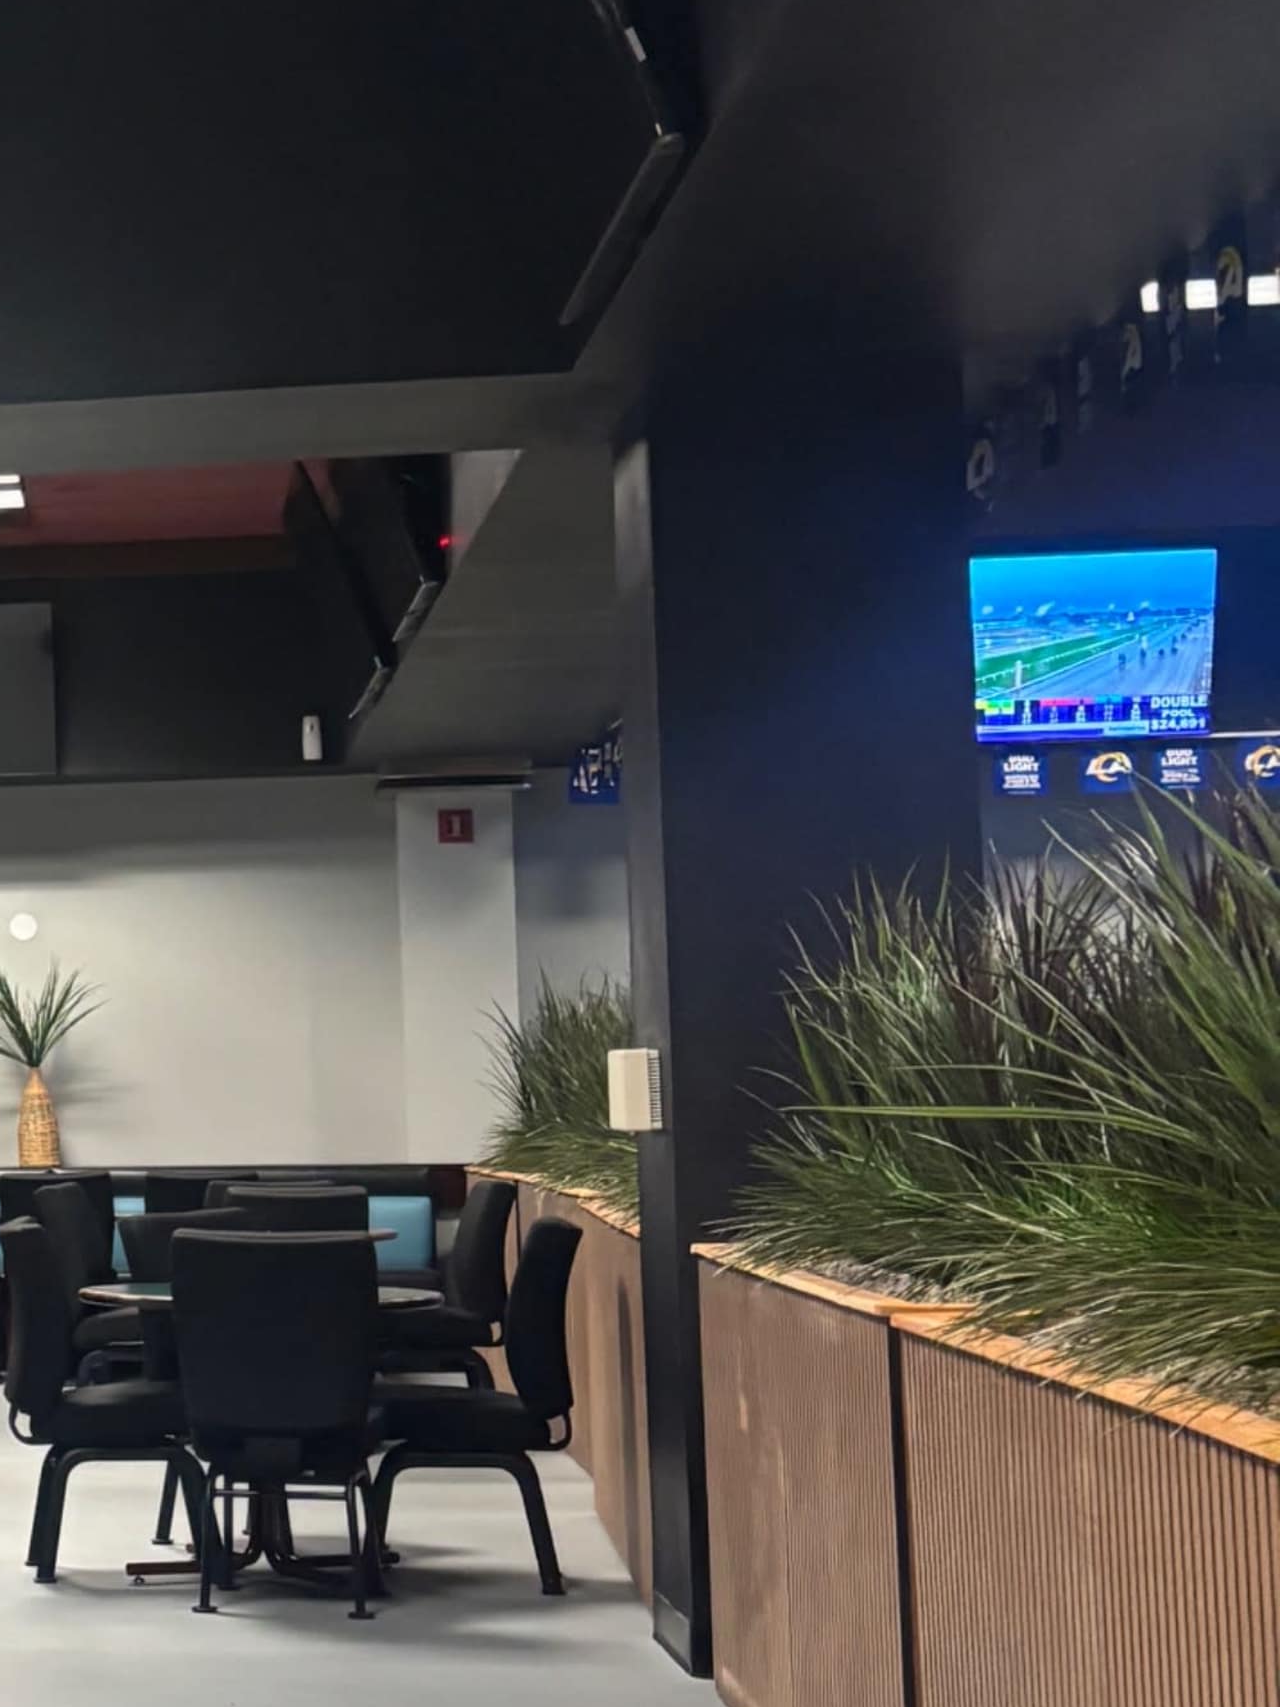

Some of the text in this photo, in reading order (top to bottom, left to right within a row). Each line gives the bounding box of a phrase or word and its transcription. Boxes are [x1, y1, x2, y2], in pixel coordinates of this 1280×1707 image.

[1150, 695, 1208, 709] DOUBLE
[1161, 708, 1195, 718] POOL
[1161, 756, 1198, 766] LIGHT
[1003, 762, 1039, 772] LIGHT
